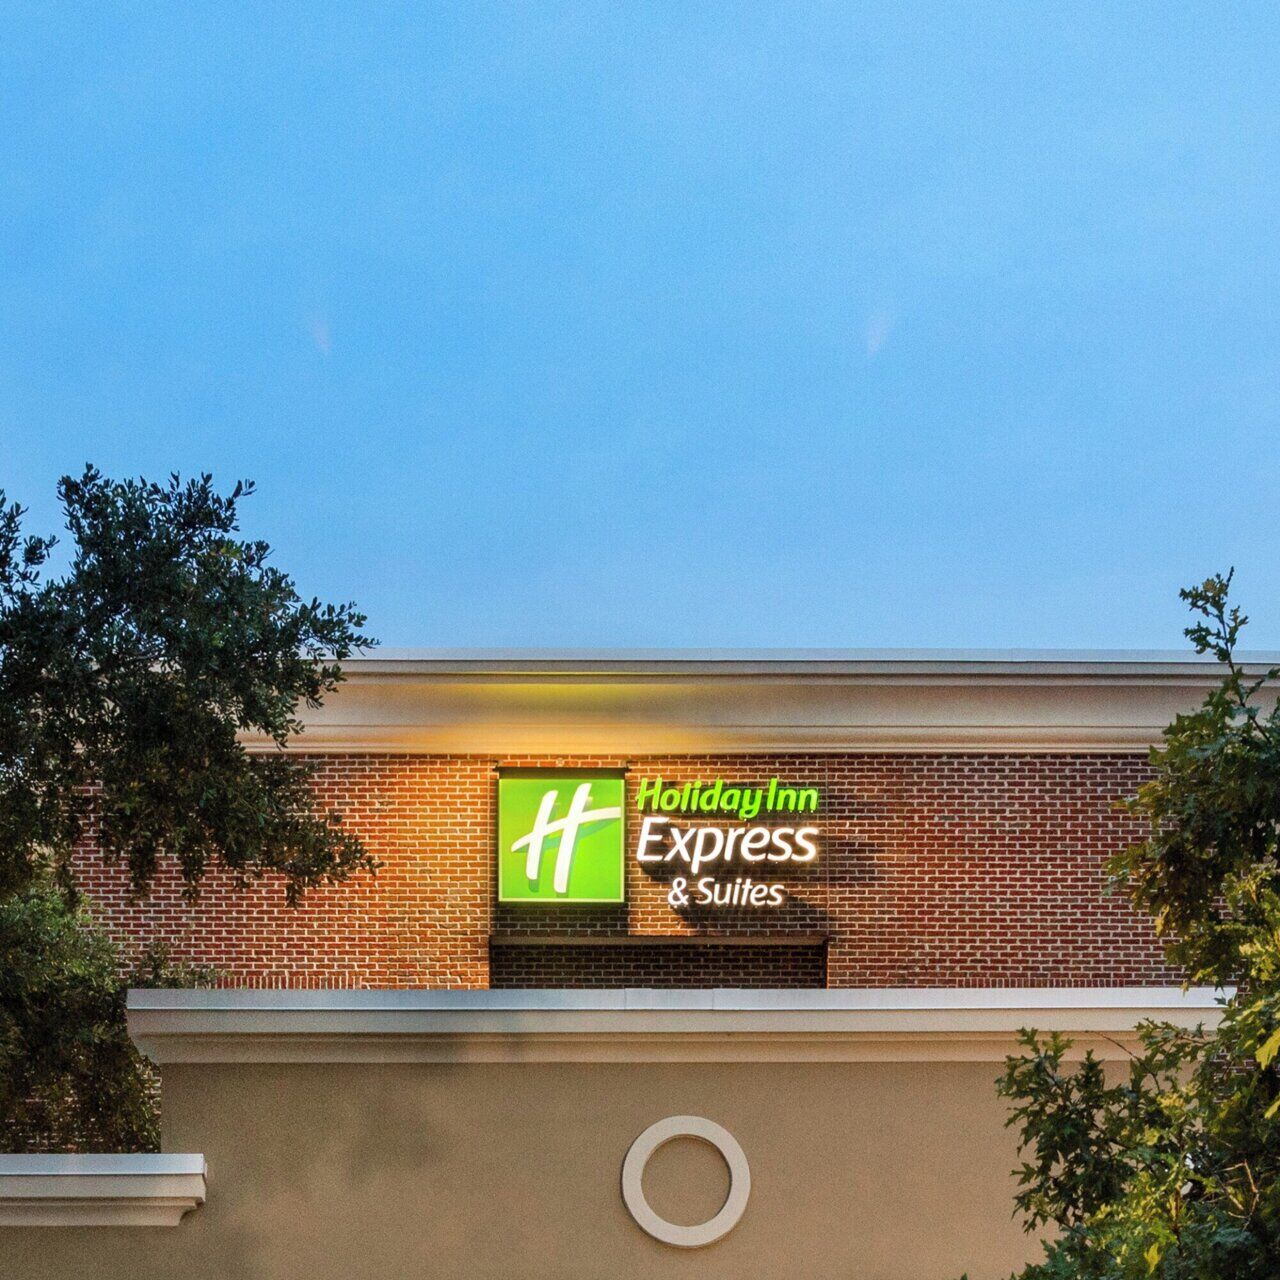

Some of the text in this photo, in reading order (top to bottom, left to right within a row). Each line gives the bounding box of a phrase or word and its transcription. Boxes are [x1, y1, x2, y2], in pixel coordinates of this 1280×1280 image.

[637, 778, 818, 819] Holiday Inn
[637, 816, 819, 875] Express
[667, 877, 785, 907] & Suites
